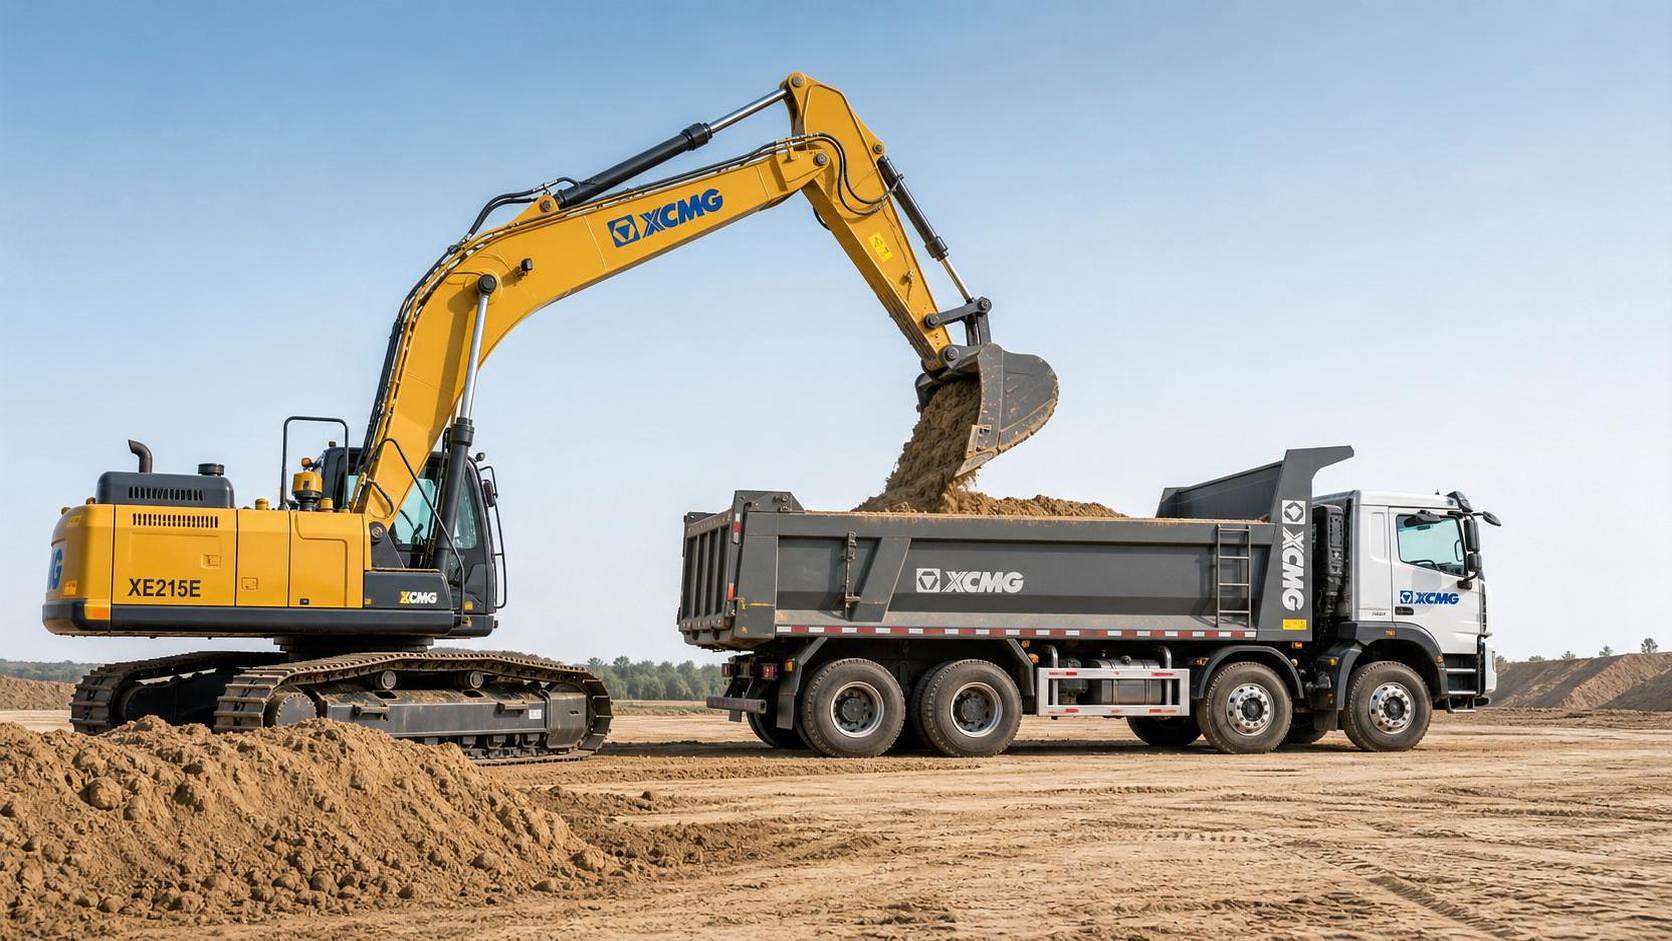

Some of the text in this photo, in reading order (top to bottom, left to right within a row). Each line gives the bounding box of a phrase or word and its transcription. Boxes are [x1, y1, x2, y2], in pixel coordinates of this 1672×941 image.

[640, 189, 723, 238] XCMG
[1282, 526, 1304, 611] XCMG
[128, 578, 201, 597] XE215E
[941, 571, 1024, 593] XCMG
[400, 591, 437, 604] XCMG
[1414, 592, 1459, 604] XCMG
